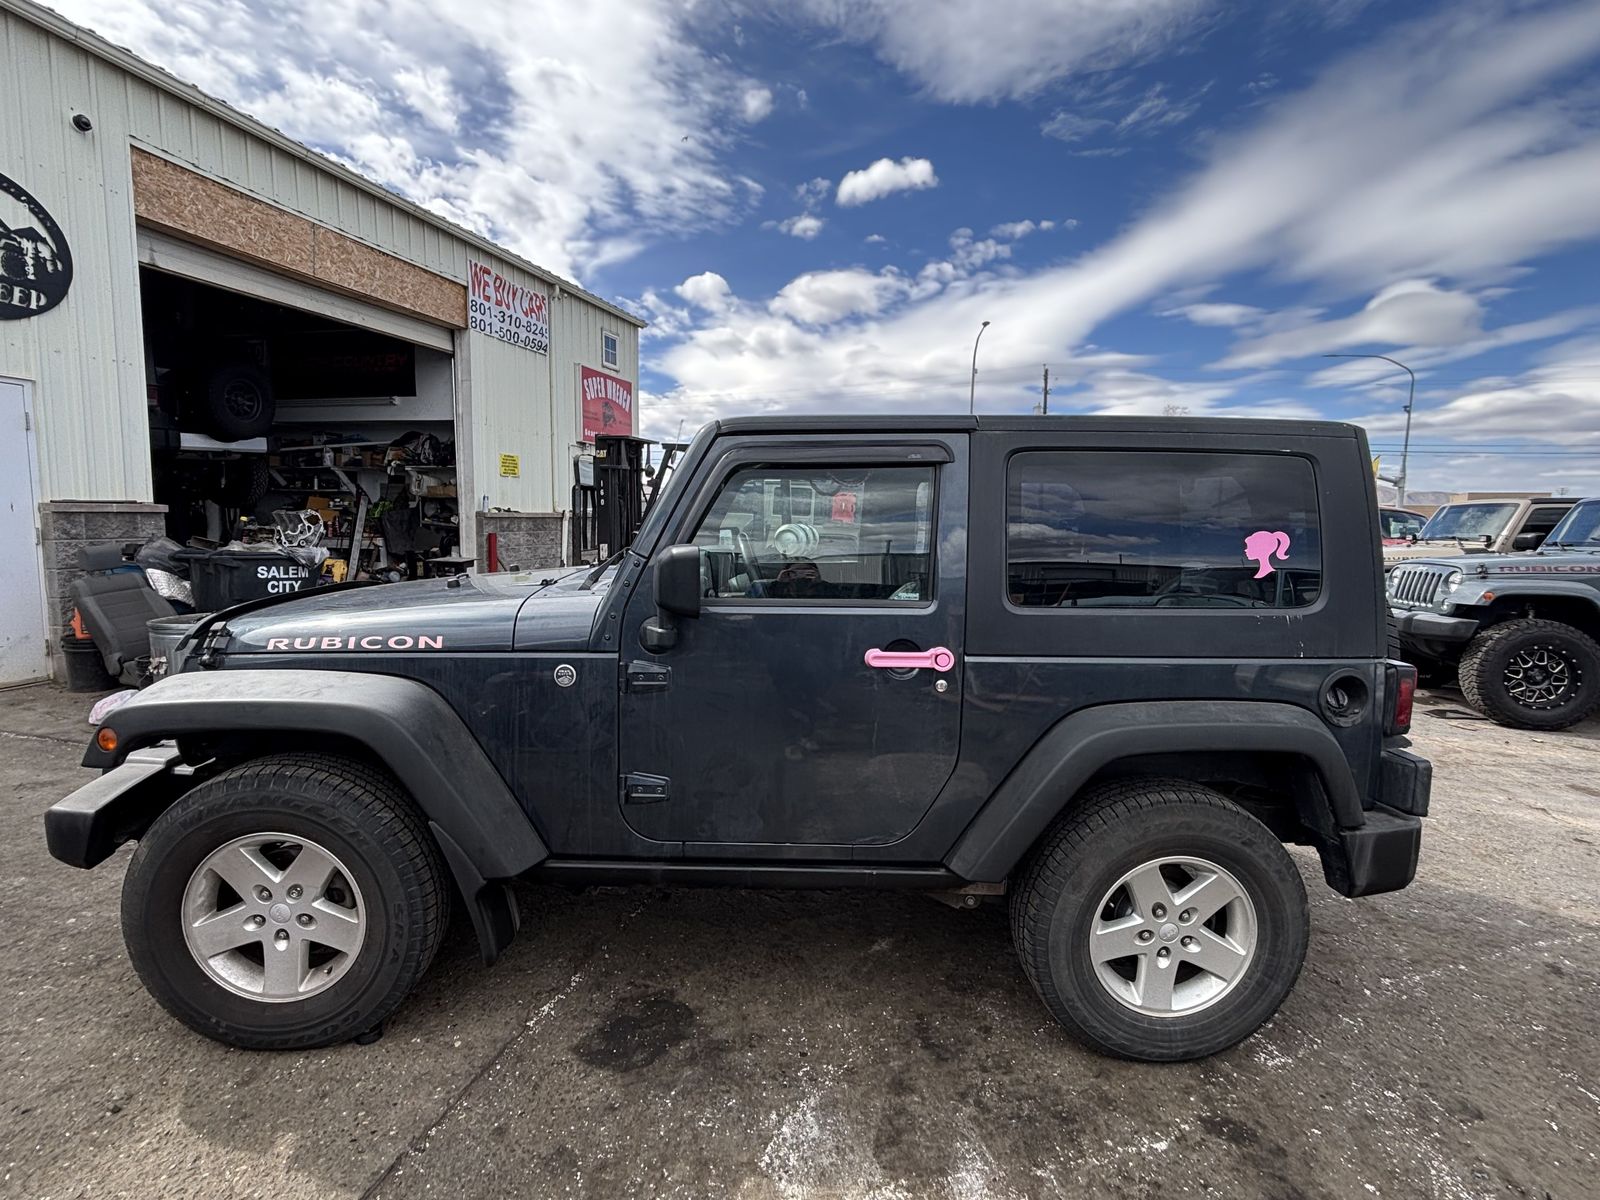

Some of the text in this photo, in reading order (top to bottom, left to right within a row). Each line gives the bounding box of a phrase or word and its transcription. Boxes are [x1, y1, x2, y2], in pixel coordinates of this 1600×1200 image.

[469, 260, 491, 303] WE
[493, 273, 518, 314] BUY
[0, 282, 47, 309] EEP
[470, 316, 548, 353] 801-500-0594
[583, 377, 631, 413] SUPER WRENCH
[595, 448, 608, 458] CAT
[256, 566, 309, 579] SALEM
[1498, 565, 1600, 573] RUBICON
[267, 581, 302, 593] CITY
[266, 635, 444, 651] RUBICON
